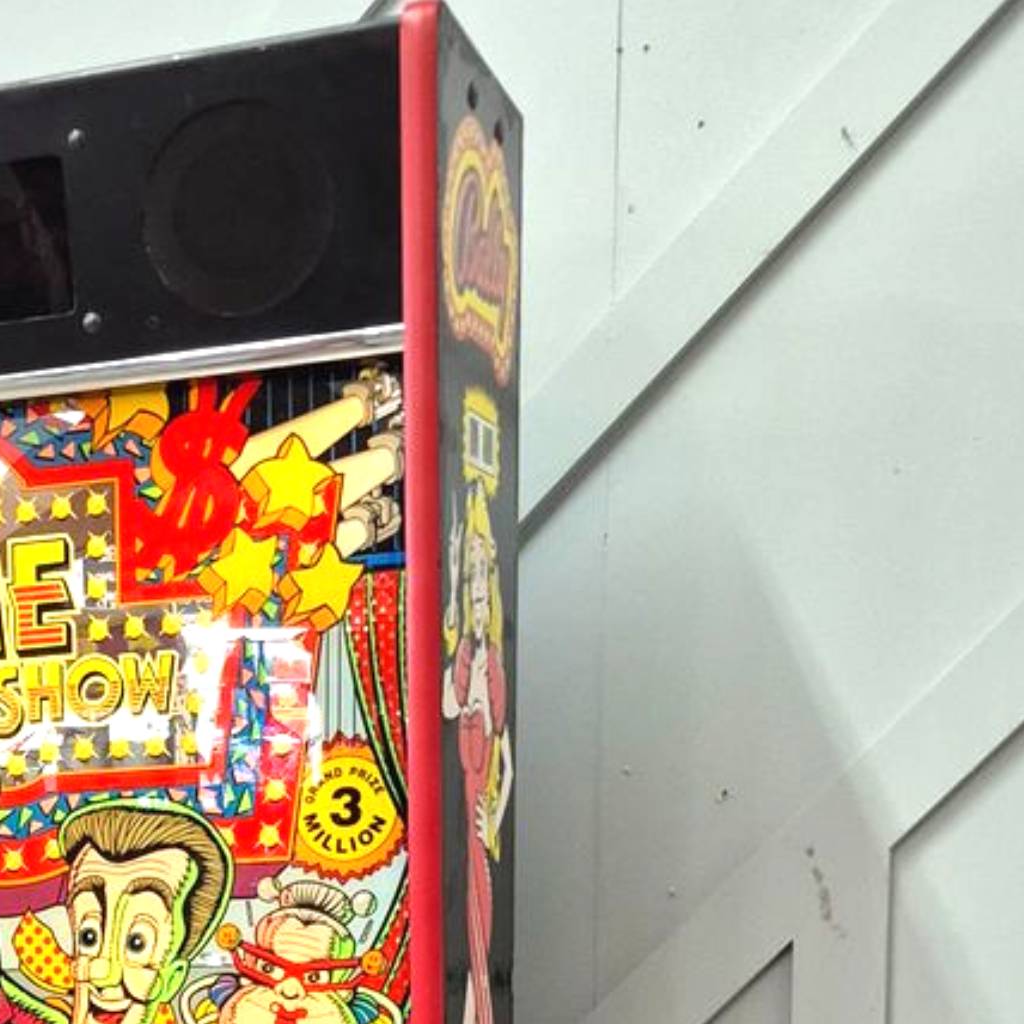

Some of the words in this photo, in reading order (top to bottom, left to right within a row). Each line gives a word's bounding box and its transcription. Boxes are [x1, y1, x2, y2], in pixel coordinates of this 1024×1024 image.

[348, 767, 385, 794] PRIZE
[329, 786, 362, 828] 3
[302, 813, 387, 854] MILLION
